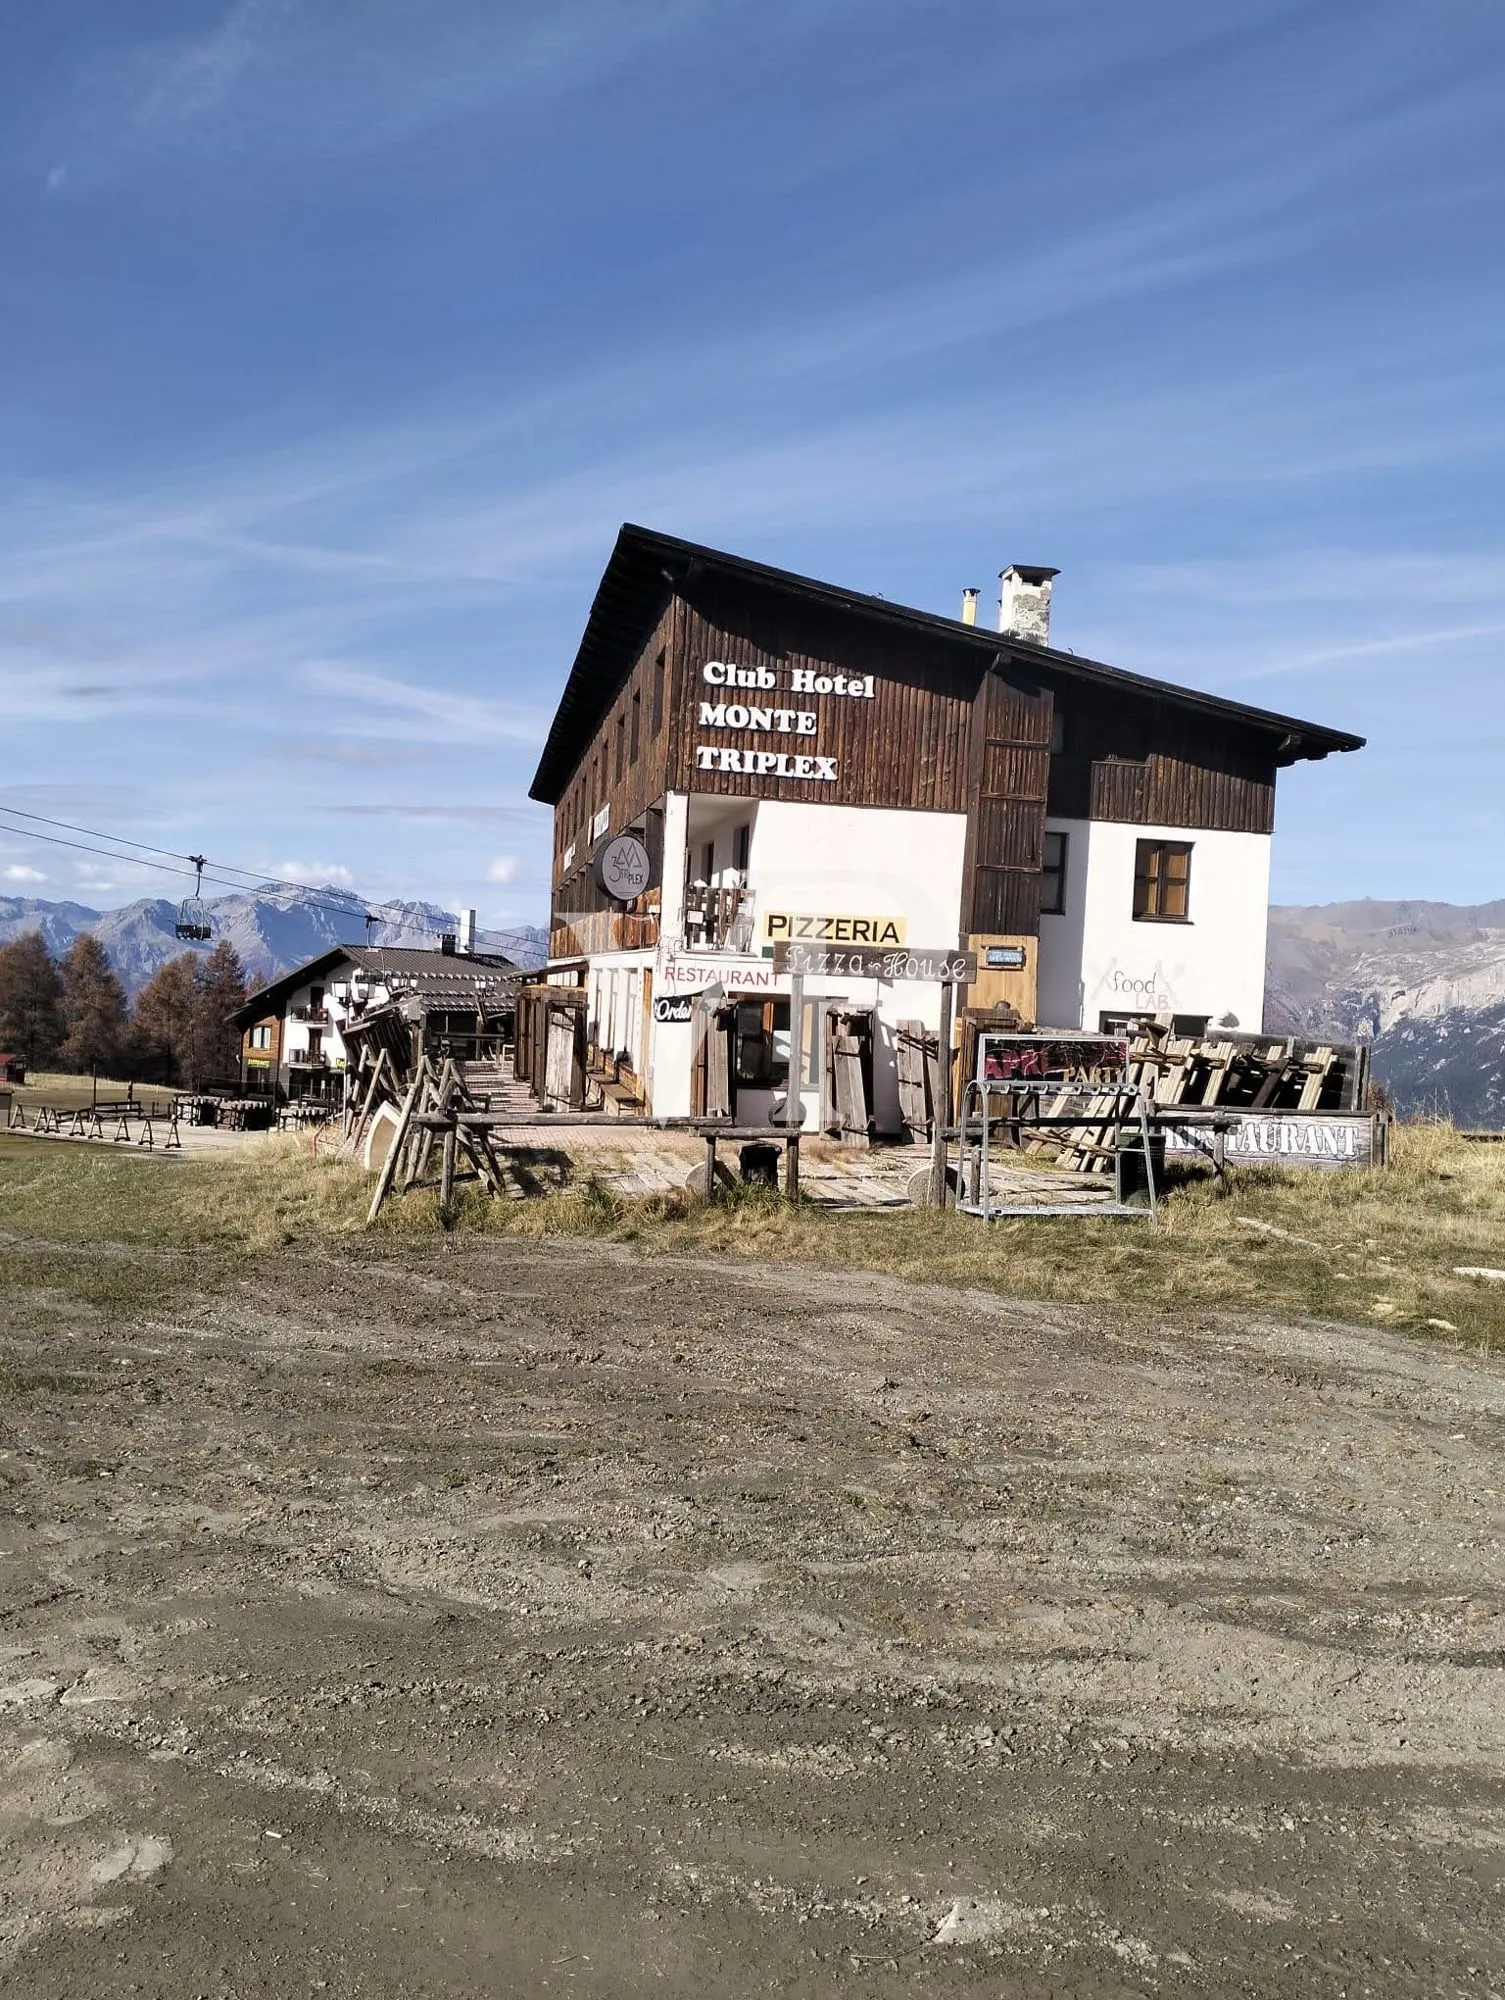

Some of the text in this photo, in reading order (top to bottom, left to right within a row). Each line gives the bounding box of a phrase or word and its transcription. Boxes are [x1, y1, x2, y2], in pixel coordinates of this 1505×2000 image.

[702, 661, 875, 698] Club Hotel
[698, 701, 818, 737] MONTE
[696, 746, 838, 780] TRIPLEX
[767, 914, 901, 944] PIZZERIA
[665, 966, 781, 987] RESTAURANT
[785, 945, 967, 979] Pizza House
[1113, 970, 1157, 994] food
